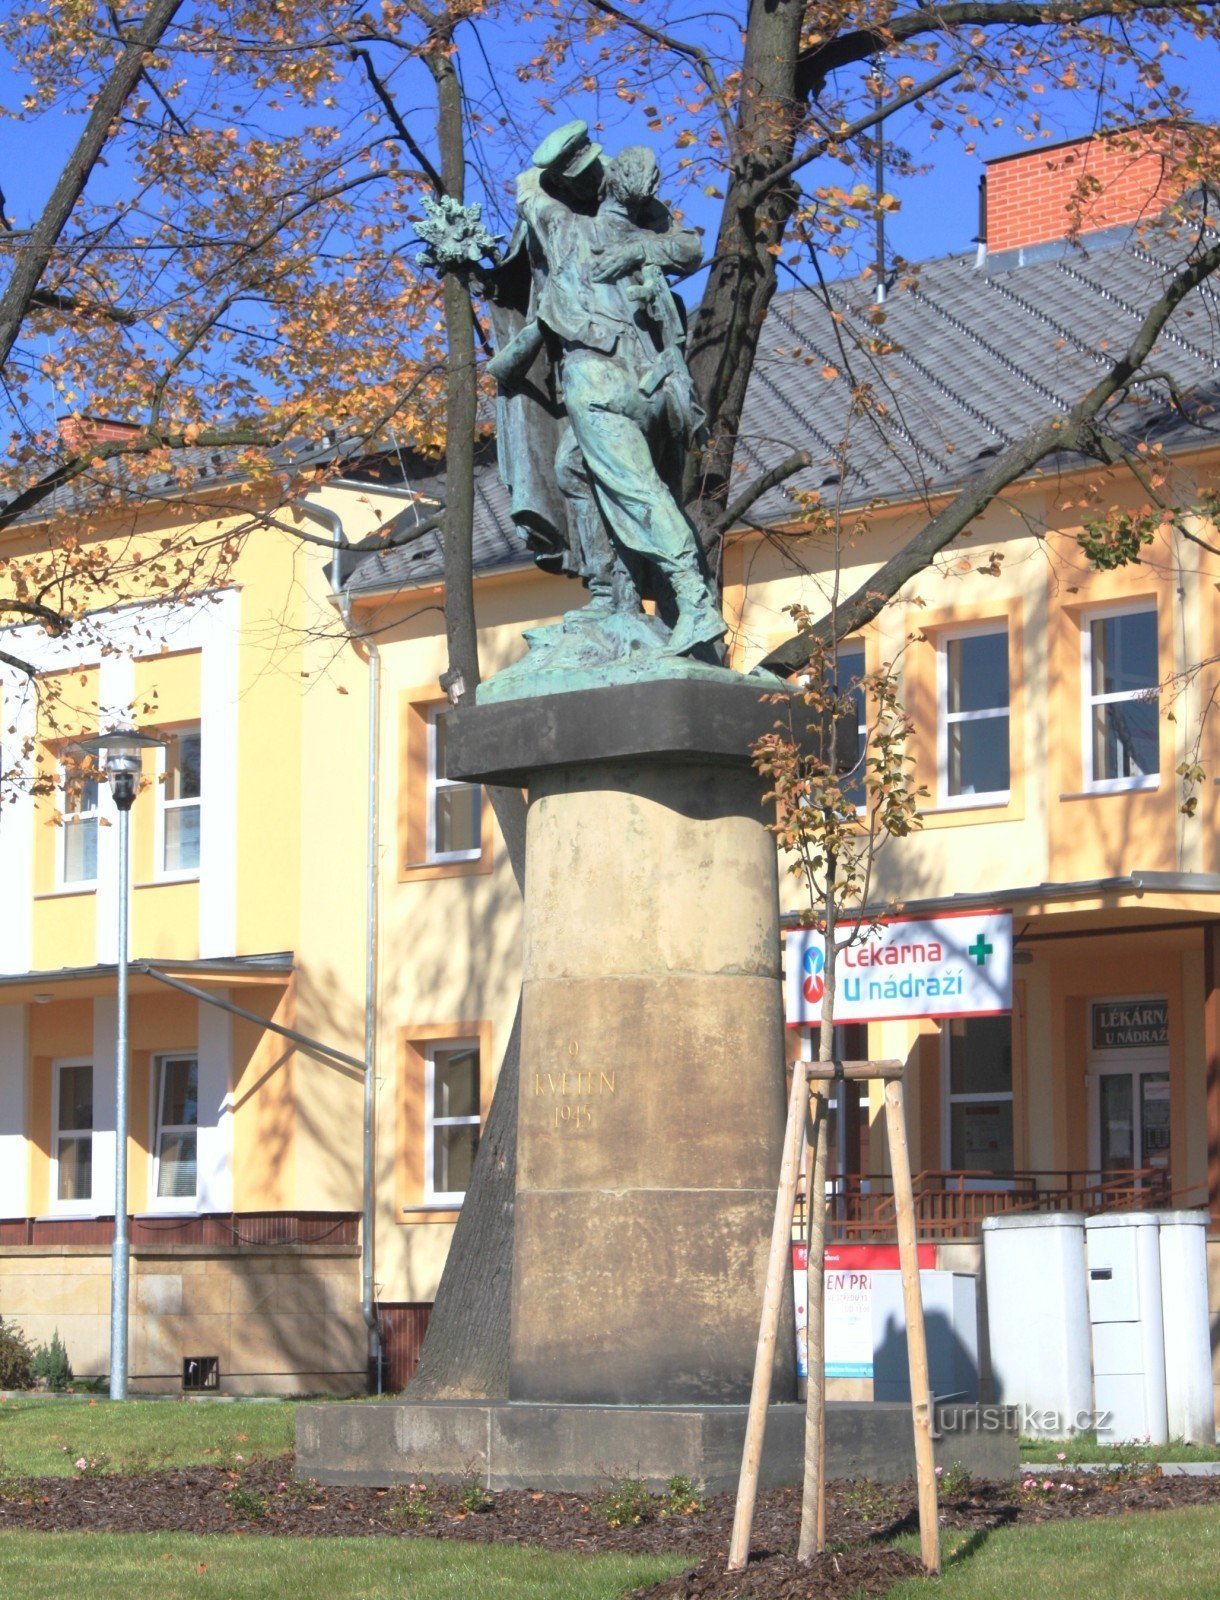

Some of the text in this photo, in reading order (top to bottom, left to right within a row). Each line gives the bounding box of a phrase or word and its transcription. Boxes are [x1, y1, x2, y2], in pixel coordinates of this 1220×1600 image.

[843, 969, 964, 1002] U nádraží
[1105, 1032, 1114, 1044] U
[555, 1103, 591, 1128] 1945
[826, 1274, 845, 1290] EN
